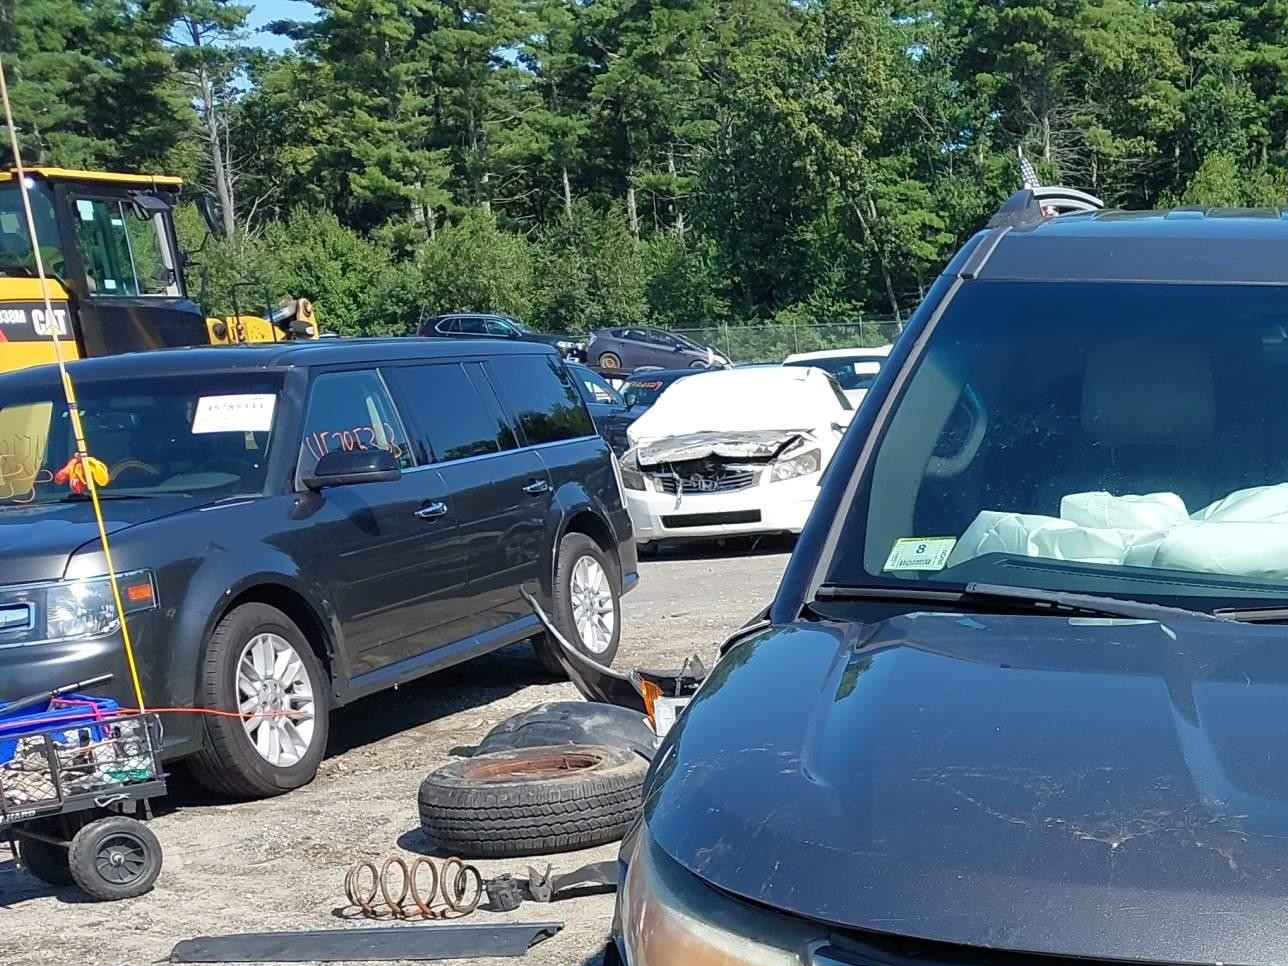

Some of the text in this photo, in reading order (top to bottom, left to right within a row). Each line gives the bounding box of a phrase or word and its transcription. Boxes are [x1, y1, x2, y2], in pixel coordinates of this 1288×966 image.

[0, 309, 67, 336] 38M CAT
[916, 544, 927, 554] 8
